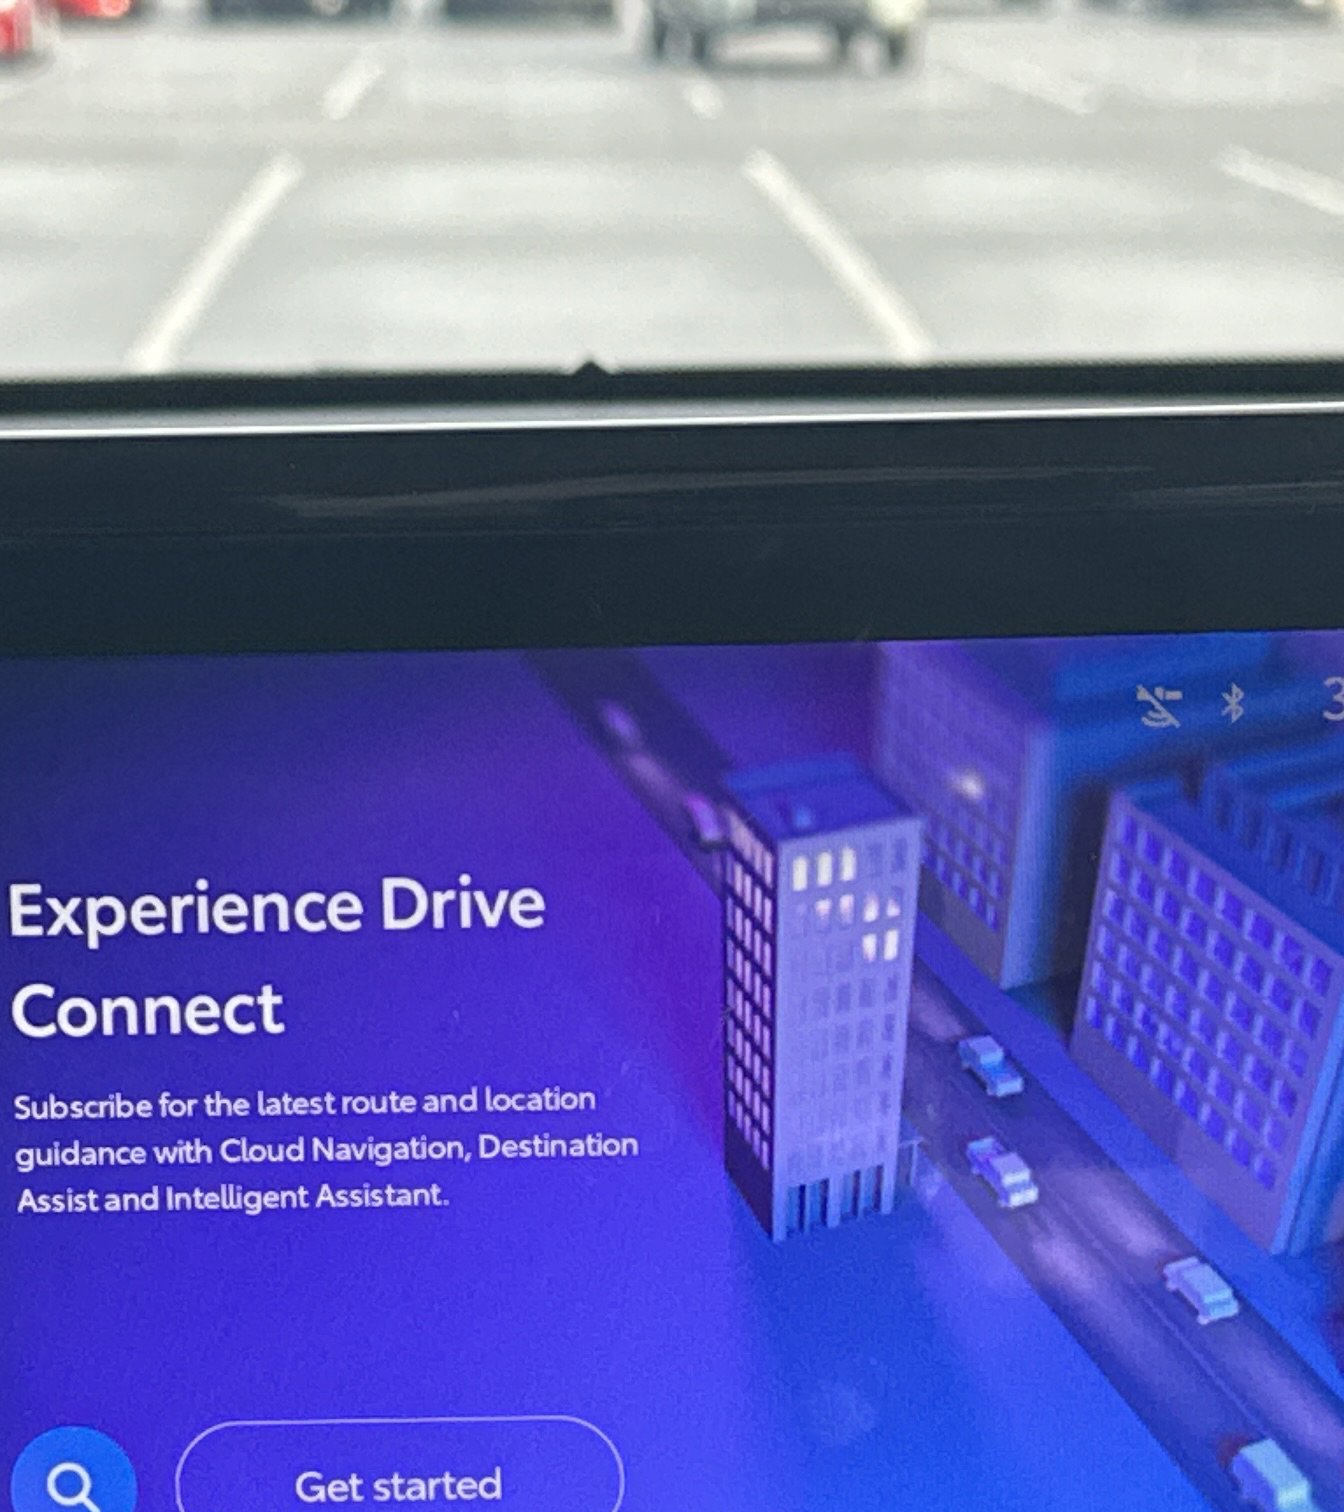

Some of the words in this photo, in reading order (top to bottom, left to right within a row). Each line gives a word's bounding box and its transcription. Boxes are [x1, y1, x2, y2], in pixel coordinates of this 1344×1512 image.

[9, 878, 364, 949] Experience
[382, 873, 546, 930] Drive
[12, 983, 285, 1038] Connect
[14, 1092, 153, 1120] Subscribe
[158, 1091, 198, 1118] for
[203, 1090, 251, 1117] the
[257, 1090, 337, 1117] latest
[341, 1091, 417, 1115] route
[422, 1086, 478, 1113] and
[485, 1086, 596, 1112] location
[15, 1140, 147, 1173] guidance
[153, 1138, 213, 1164] with
[219, 1136, 305, 1163] Cloud
[312, 1135, 472, 1167] Navigation,
[478, 1132, 639, 1159] Destination
[17, 1188, 100, 1214] Assist
[104, 1185, 159, 1212] and
[166, 1183, 310, 1216] Intelligent
[315, 1183, 450, 1208] Assistant.
[294, 1471, 364, 1503] Get
[373, 1466, 503, 1502] started
